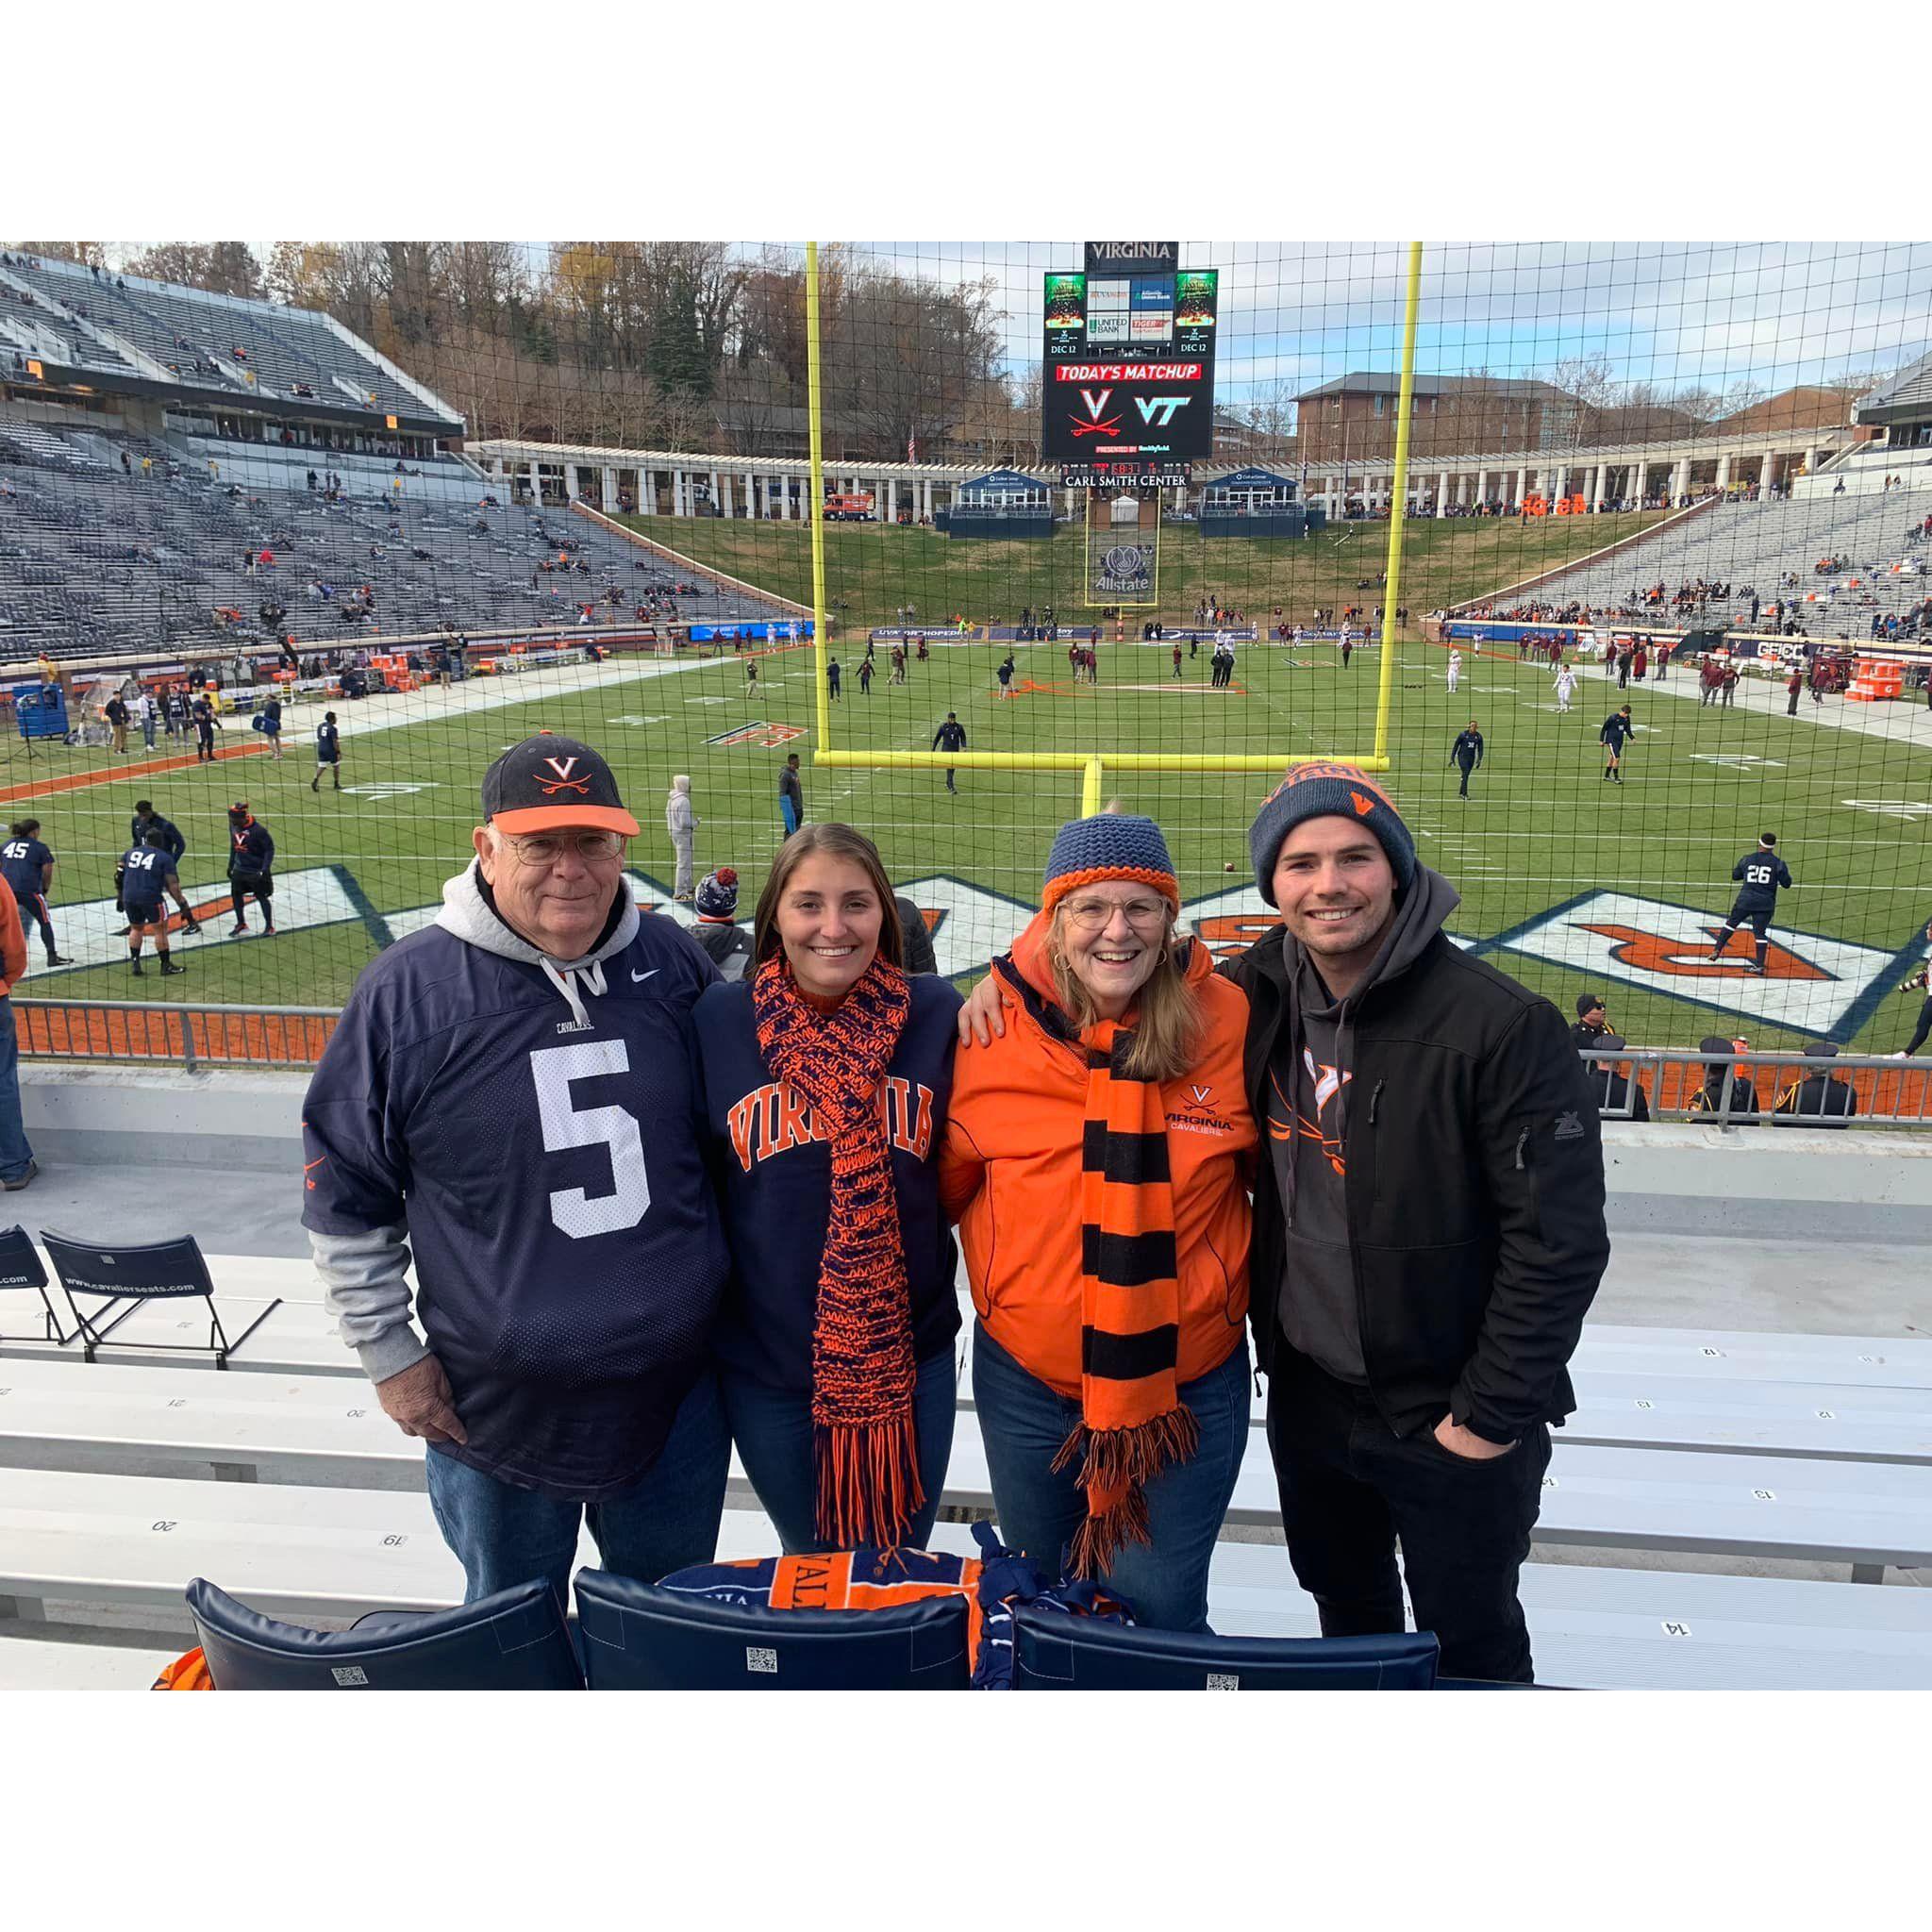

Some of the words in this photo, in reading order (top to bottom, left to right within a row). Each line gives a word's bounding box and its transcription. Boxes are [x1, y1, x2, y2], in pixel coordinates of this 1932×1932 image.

[1091, 242, 1171, 258] VIRGINIA
[1097, 318, 1126, 326] UNITED
[1051, 345, 1068, 354] DEC
[1069, 345, 1076, 354] 12
[1181, 343, 1197, 353] DEC
[1199, 343, 1207, 352] 12
[1060, 366, 1122, 380] TODAY'S
[1124, 364, 1198, 379] MATCHUP
[1134, 396, 1191, 425] VT
[1065, 476, 1096, 487] CARL
[1099, 475, 1137, 486] SMITH
[1141, 475, 1187, 486] CENTER
[1095, 576, 1149, 592] Allstate
[543, 757, 579, 781] V
[3, 841, 29, 859] 45
[128, 851, 156, 870] 94
[1746, 865, 1772, 884] 26
[529, 1039, 651, 1240] 5
[65, 1276, 195, 1293] www.cavalierseats.com
[1703, 1348, 1716, 1357] 12
[346, 1409, 367, 1418] 20
[1754, 1490, 1772, 1501] 13
[151, 1520, 178, 1533] 20
[383, 1534, 402, 1546] 19
[1665, 1623, 1689, 1636] 14
